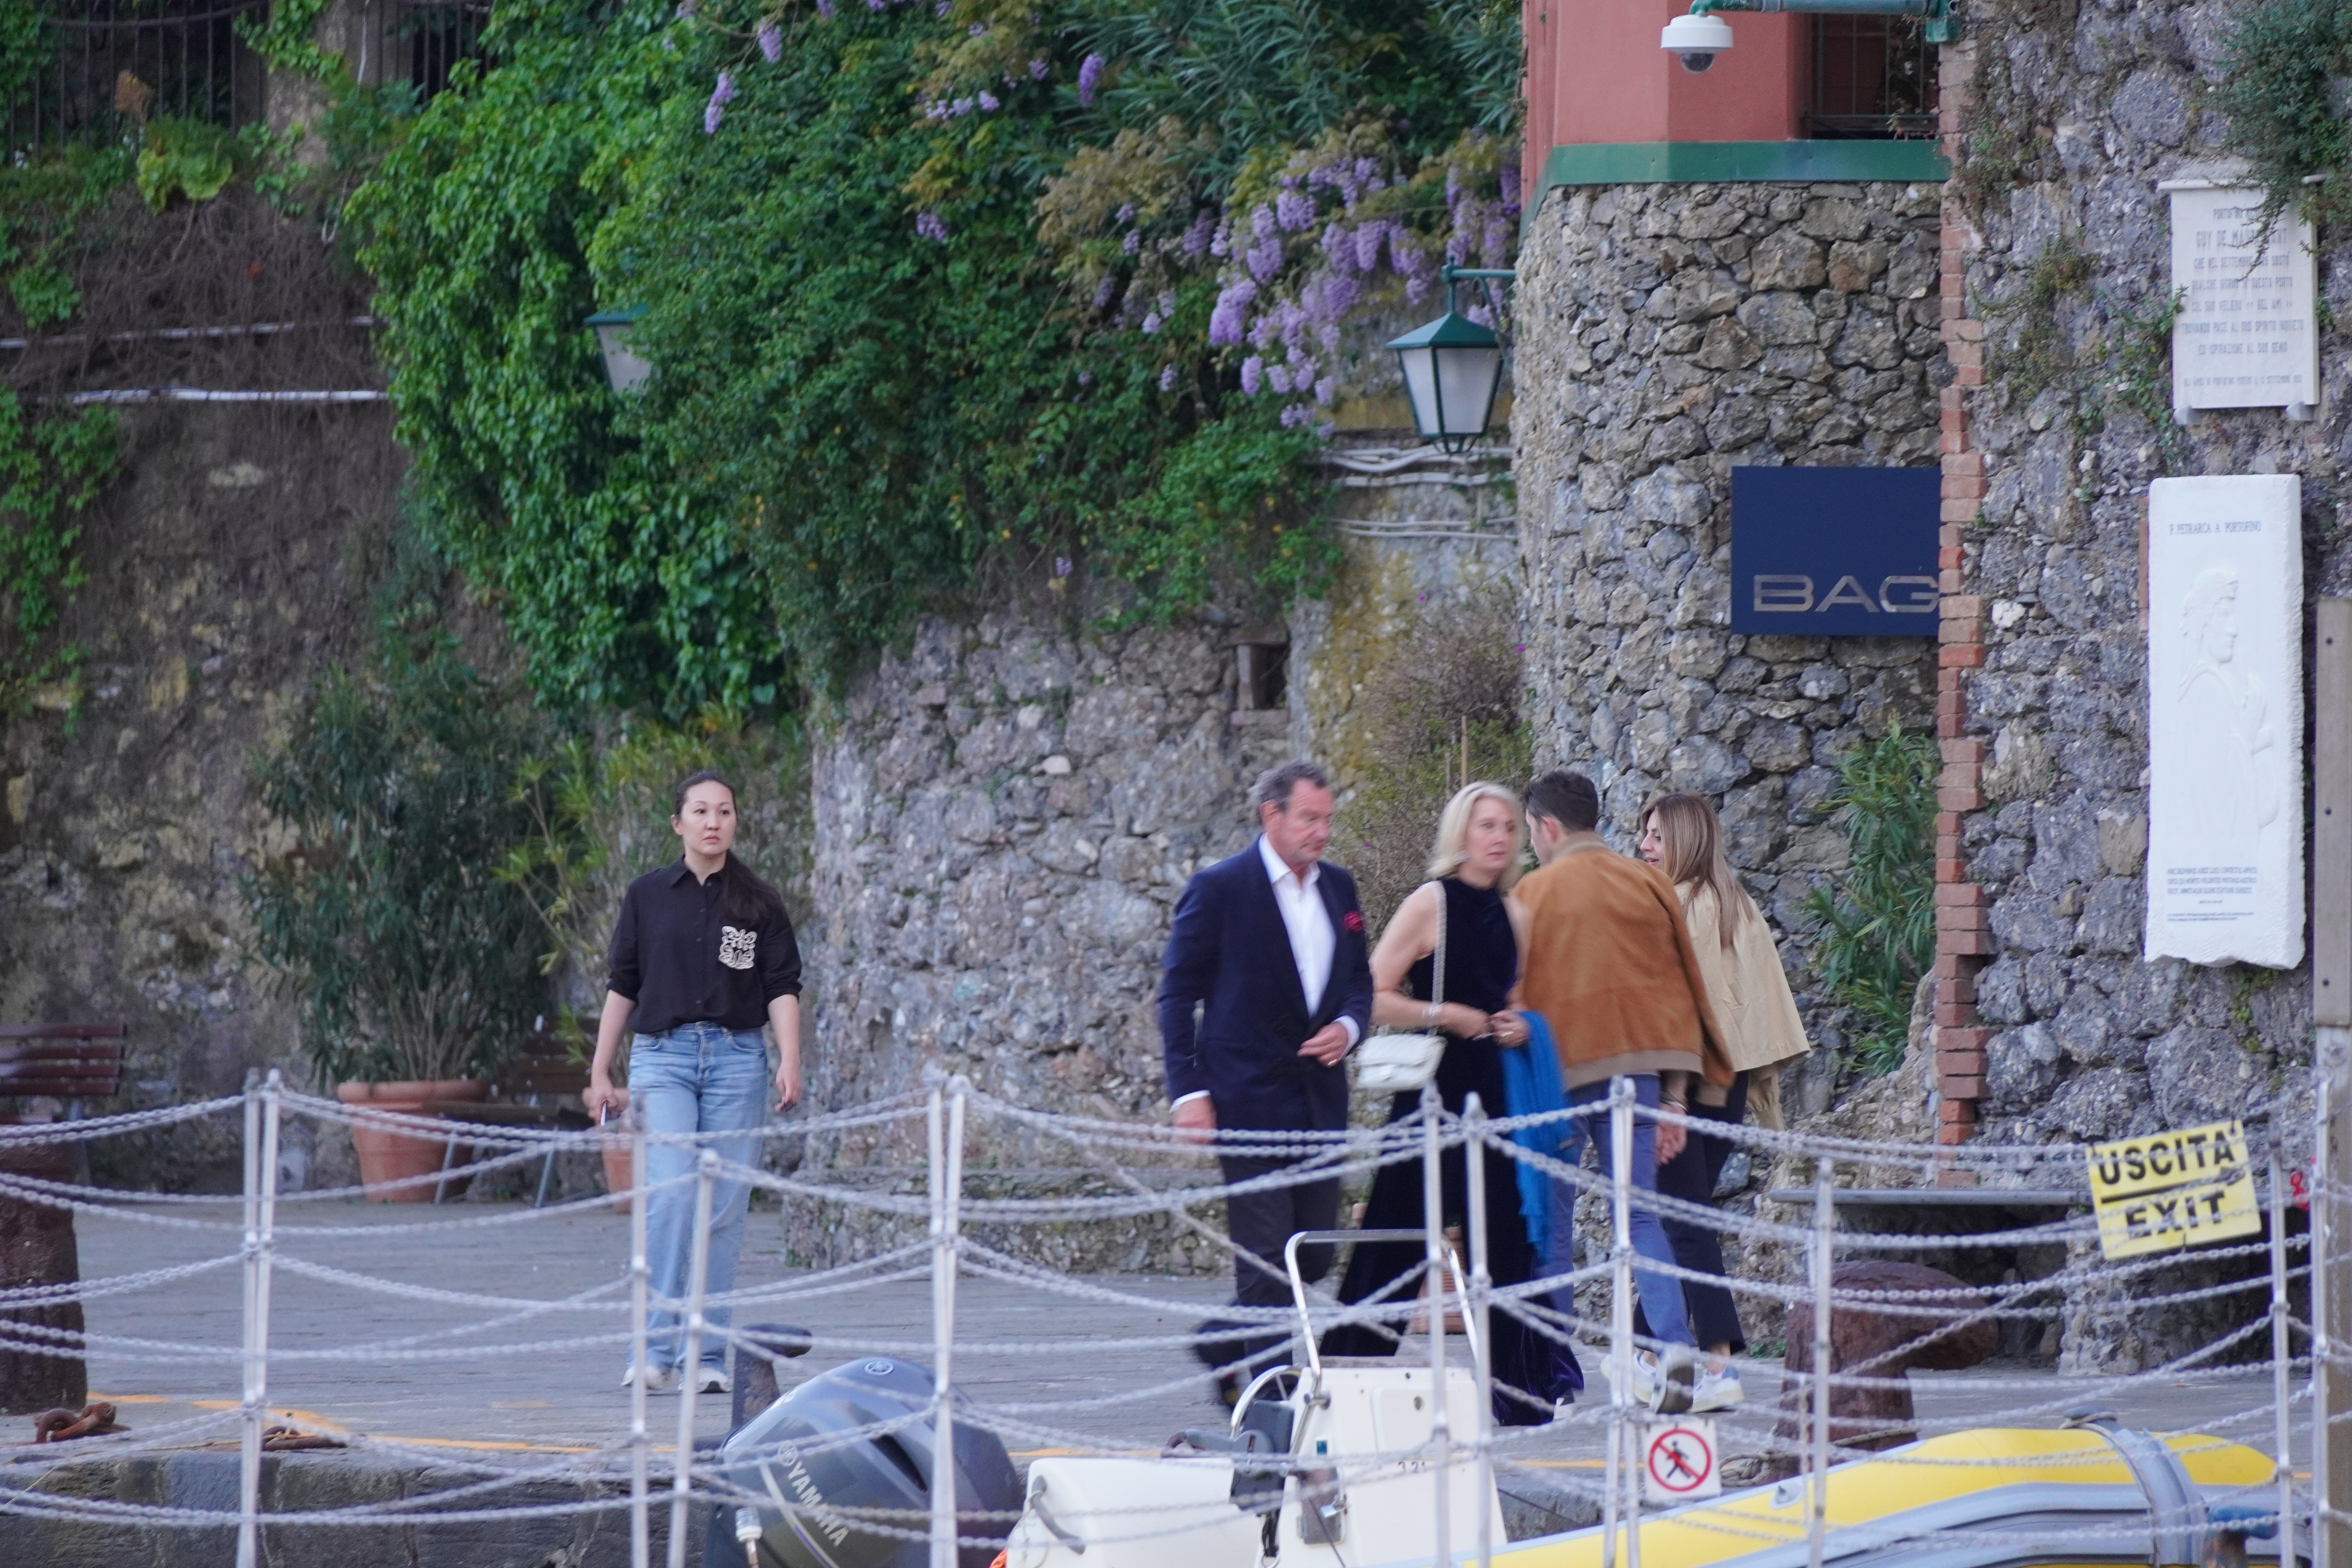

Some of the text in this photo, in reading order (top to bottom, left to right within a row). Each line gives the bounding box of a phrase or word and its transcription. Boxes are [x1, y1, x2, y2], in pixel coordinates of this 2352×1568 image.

[2196, 230, 2213, 247] GUY
[2217, 229, 2226, 247] DE
[2276, 276, 2292, 288] PORTO
[2257, 299, 2268, 310] BEL
[2177, 523, 2212, 535] PETRARCA
[2215, 522, 2221, 533] A
[2225, 521, 2262, 533] PORTOFINO
[2098, 1130, 2235, 1185] USCITA
[2125, 1191, 2225, 1239] EXIT
[788, 1460, 850, 1547] YAMAHA
